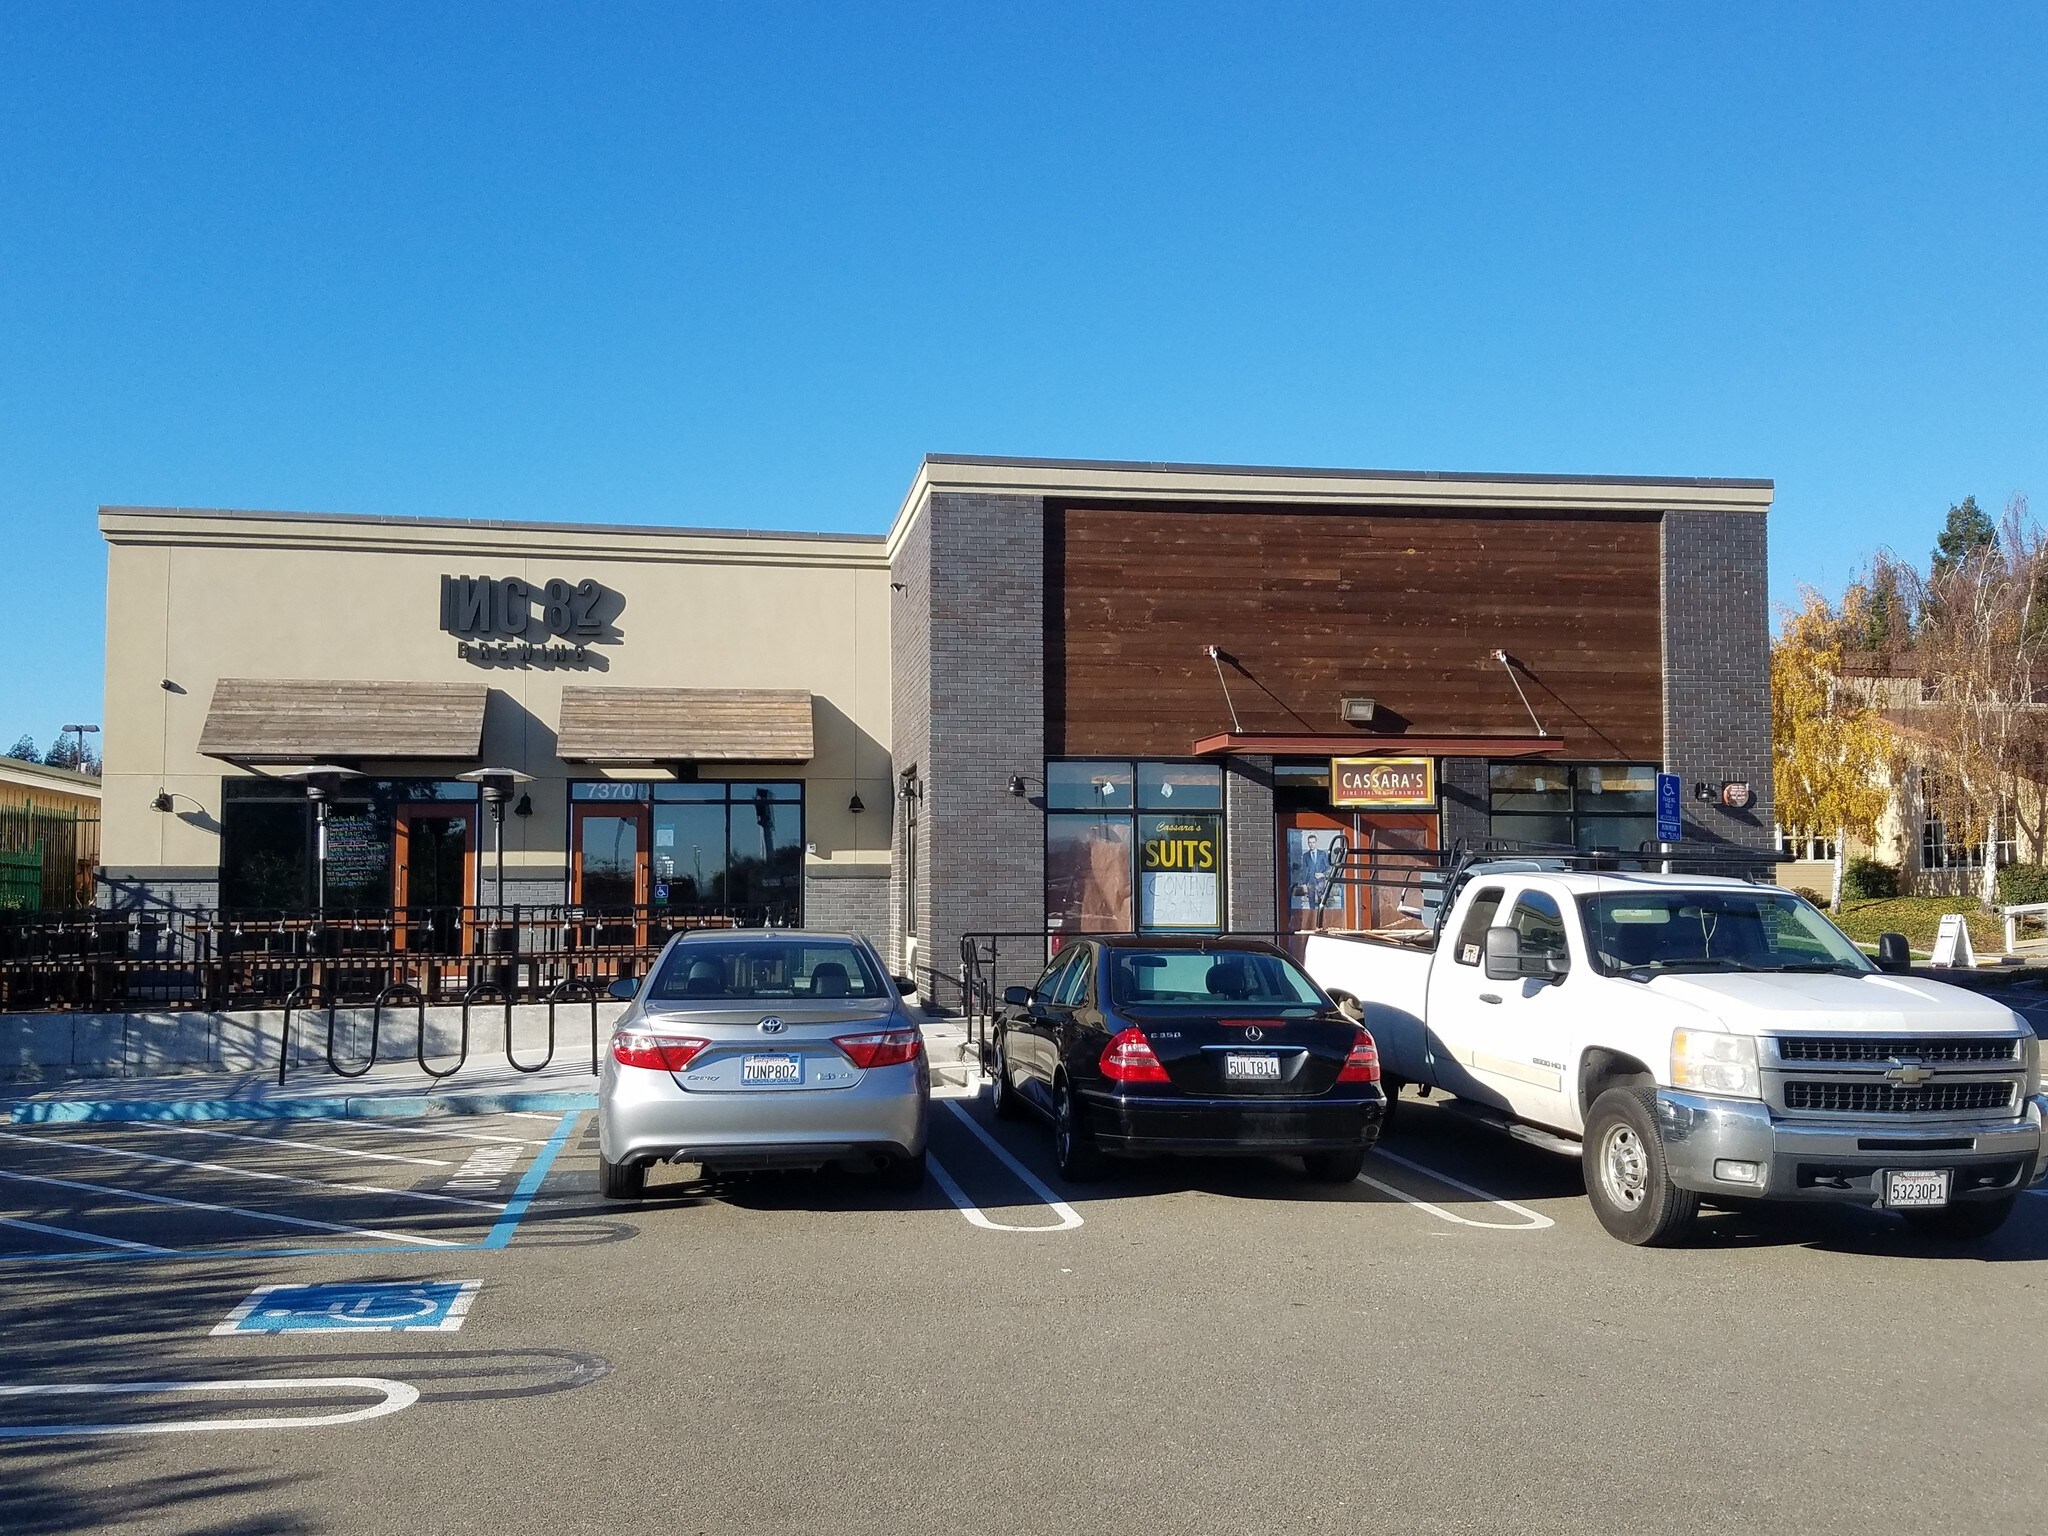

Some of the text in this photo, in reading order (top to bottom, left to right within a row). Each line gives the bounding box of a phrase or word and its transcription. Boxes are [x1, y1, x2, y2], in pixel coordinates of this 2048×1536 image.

[544, 578, 601, 635] 82
[457, 641, 586, 662] BREWING
[1342, 772, 1423, 789] CASSARA'S
[587, 783, 634, 799] 7370
[1156, 821, 1202, 832] Cassara's
[1145, 840, 1213, 868] SUITS
[1149, 875, 1216, 897] COMING
[745, 1065, 797, 1079] 7UNP802
[1229, 1061, 1277, 1075] 5ULT814
[439, 1179, 502, 1192] NO
[1892, 1183, 1944, 1200] 53230P1
